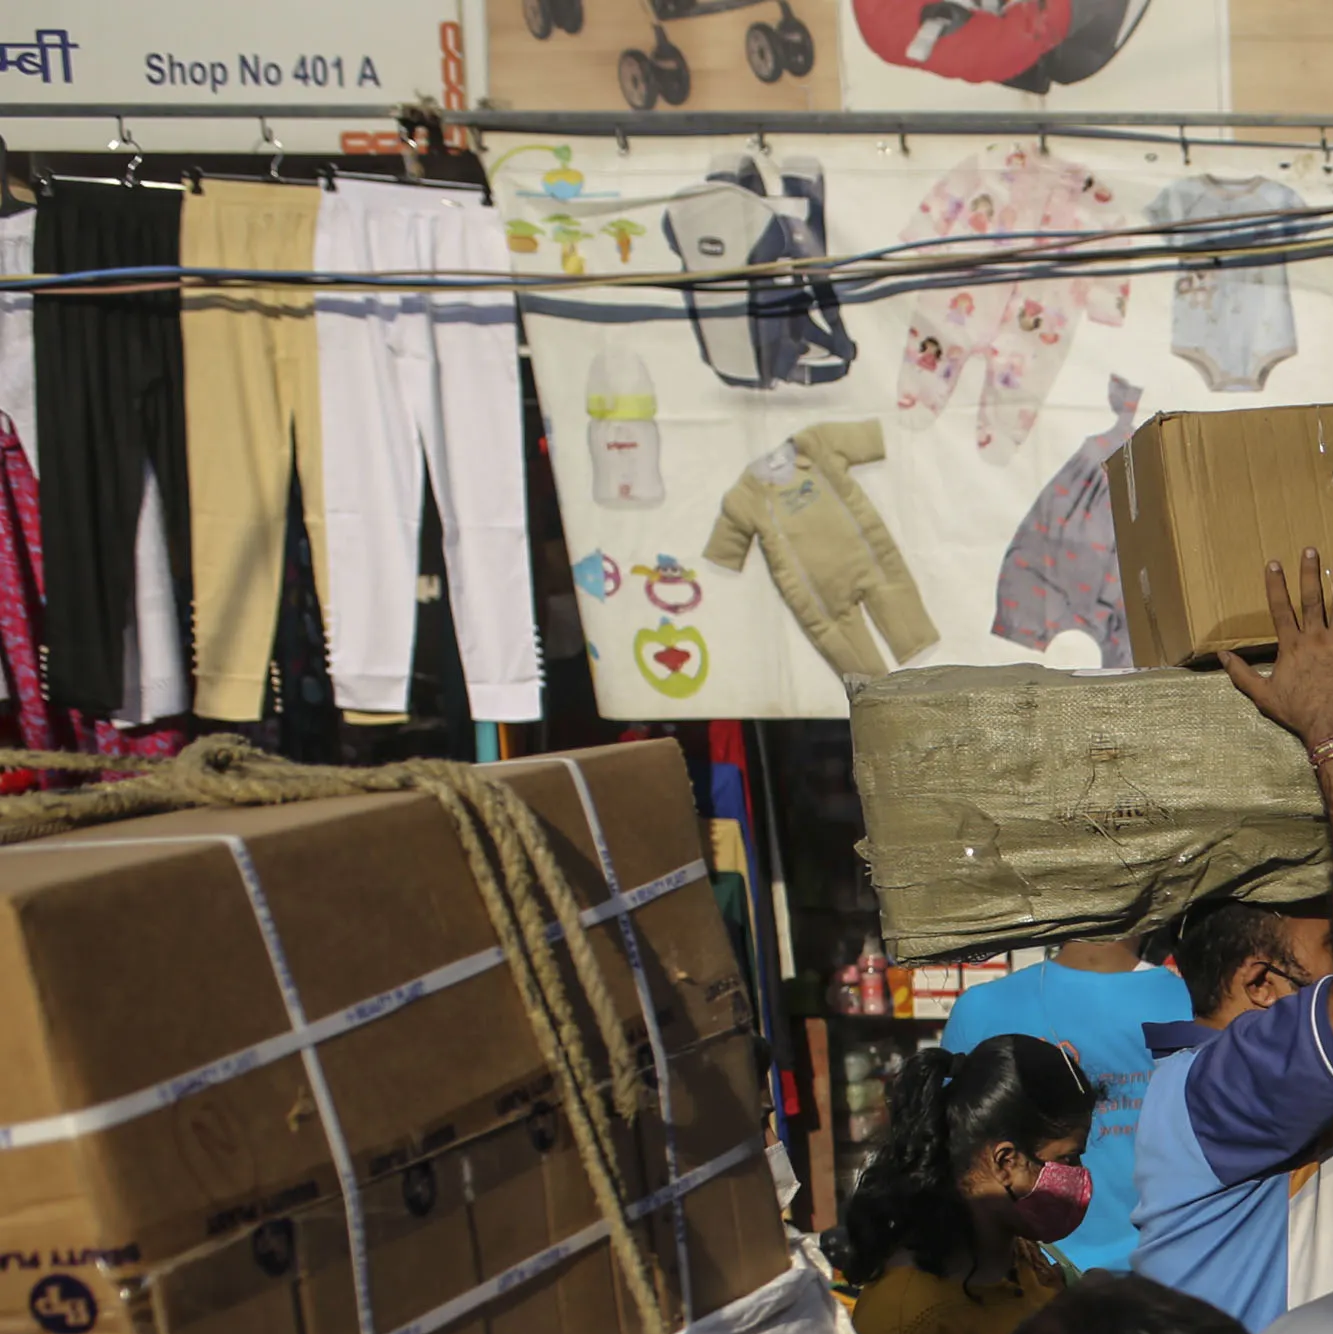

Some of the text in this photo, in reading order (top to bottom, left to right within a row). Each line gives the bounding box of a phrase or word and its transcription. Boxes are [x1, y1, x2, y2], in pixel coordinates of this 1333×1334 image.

[145, 52, 381, 93] Shop No 401 A
